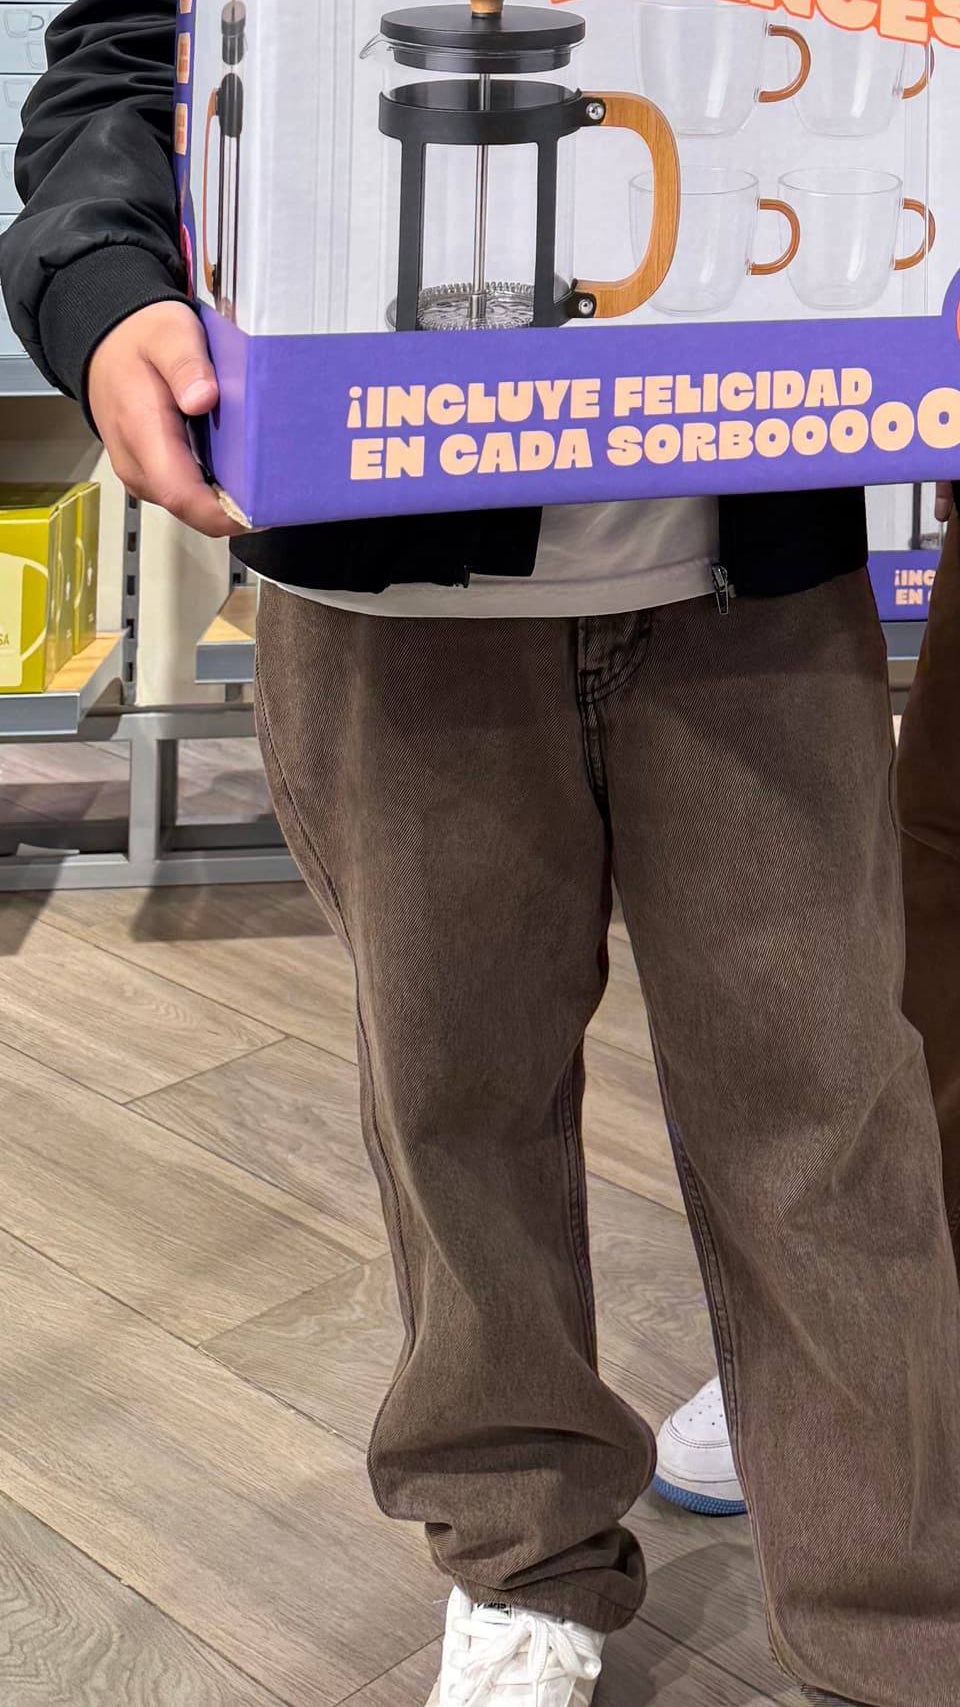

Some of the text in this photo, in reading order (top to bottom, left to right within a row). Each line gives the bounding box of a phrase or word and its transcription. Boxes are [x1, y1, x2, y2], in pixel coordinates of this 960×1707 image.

[347, 367, 873, 429] ¡INCLUYE FELICIDAD
[349, 435, 425, 481] EN
[439, 428, 593, 475] CADA
[894, 569, 937, 586] ¡INC
[895, 588, 923, 605] EN
